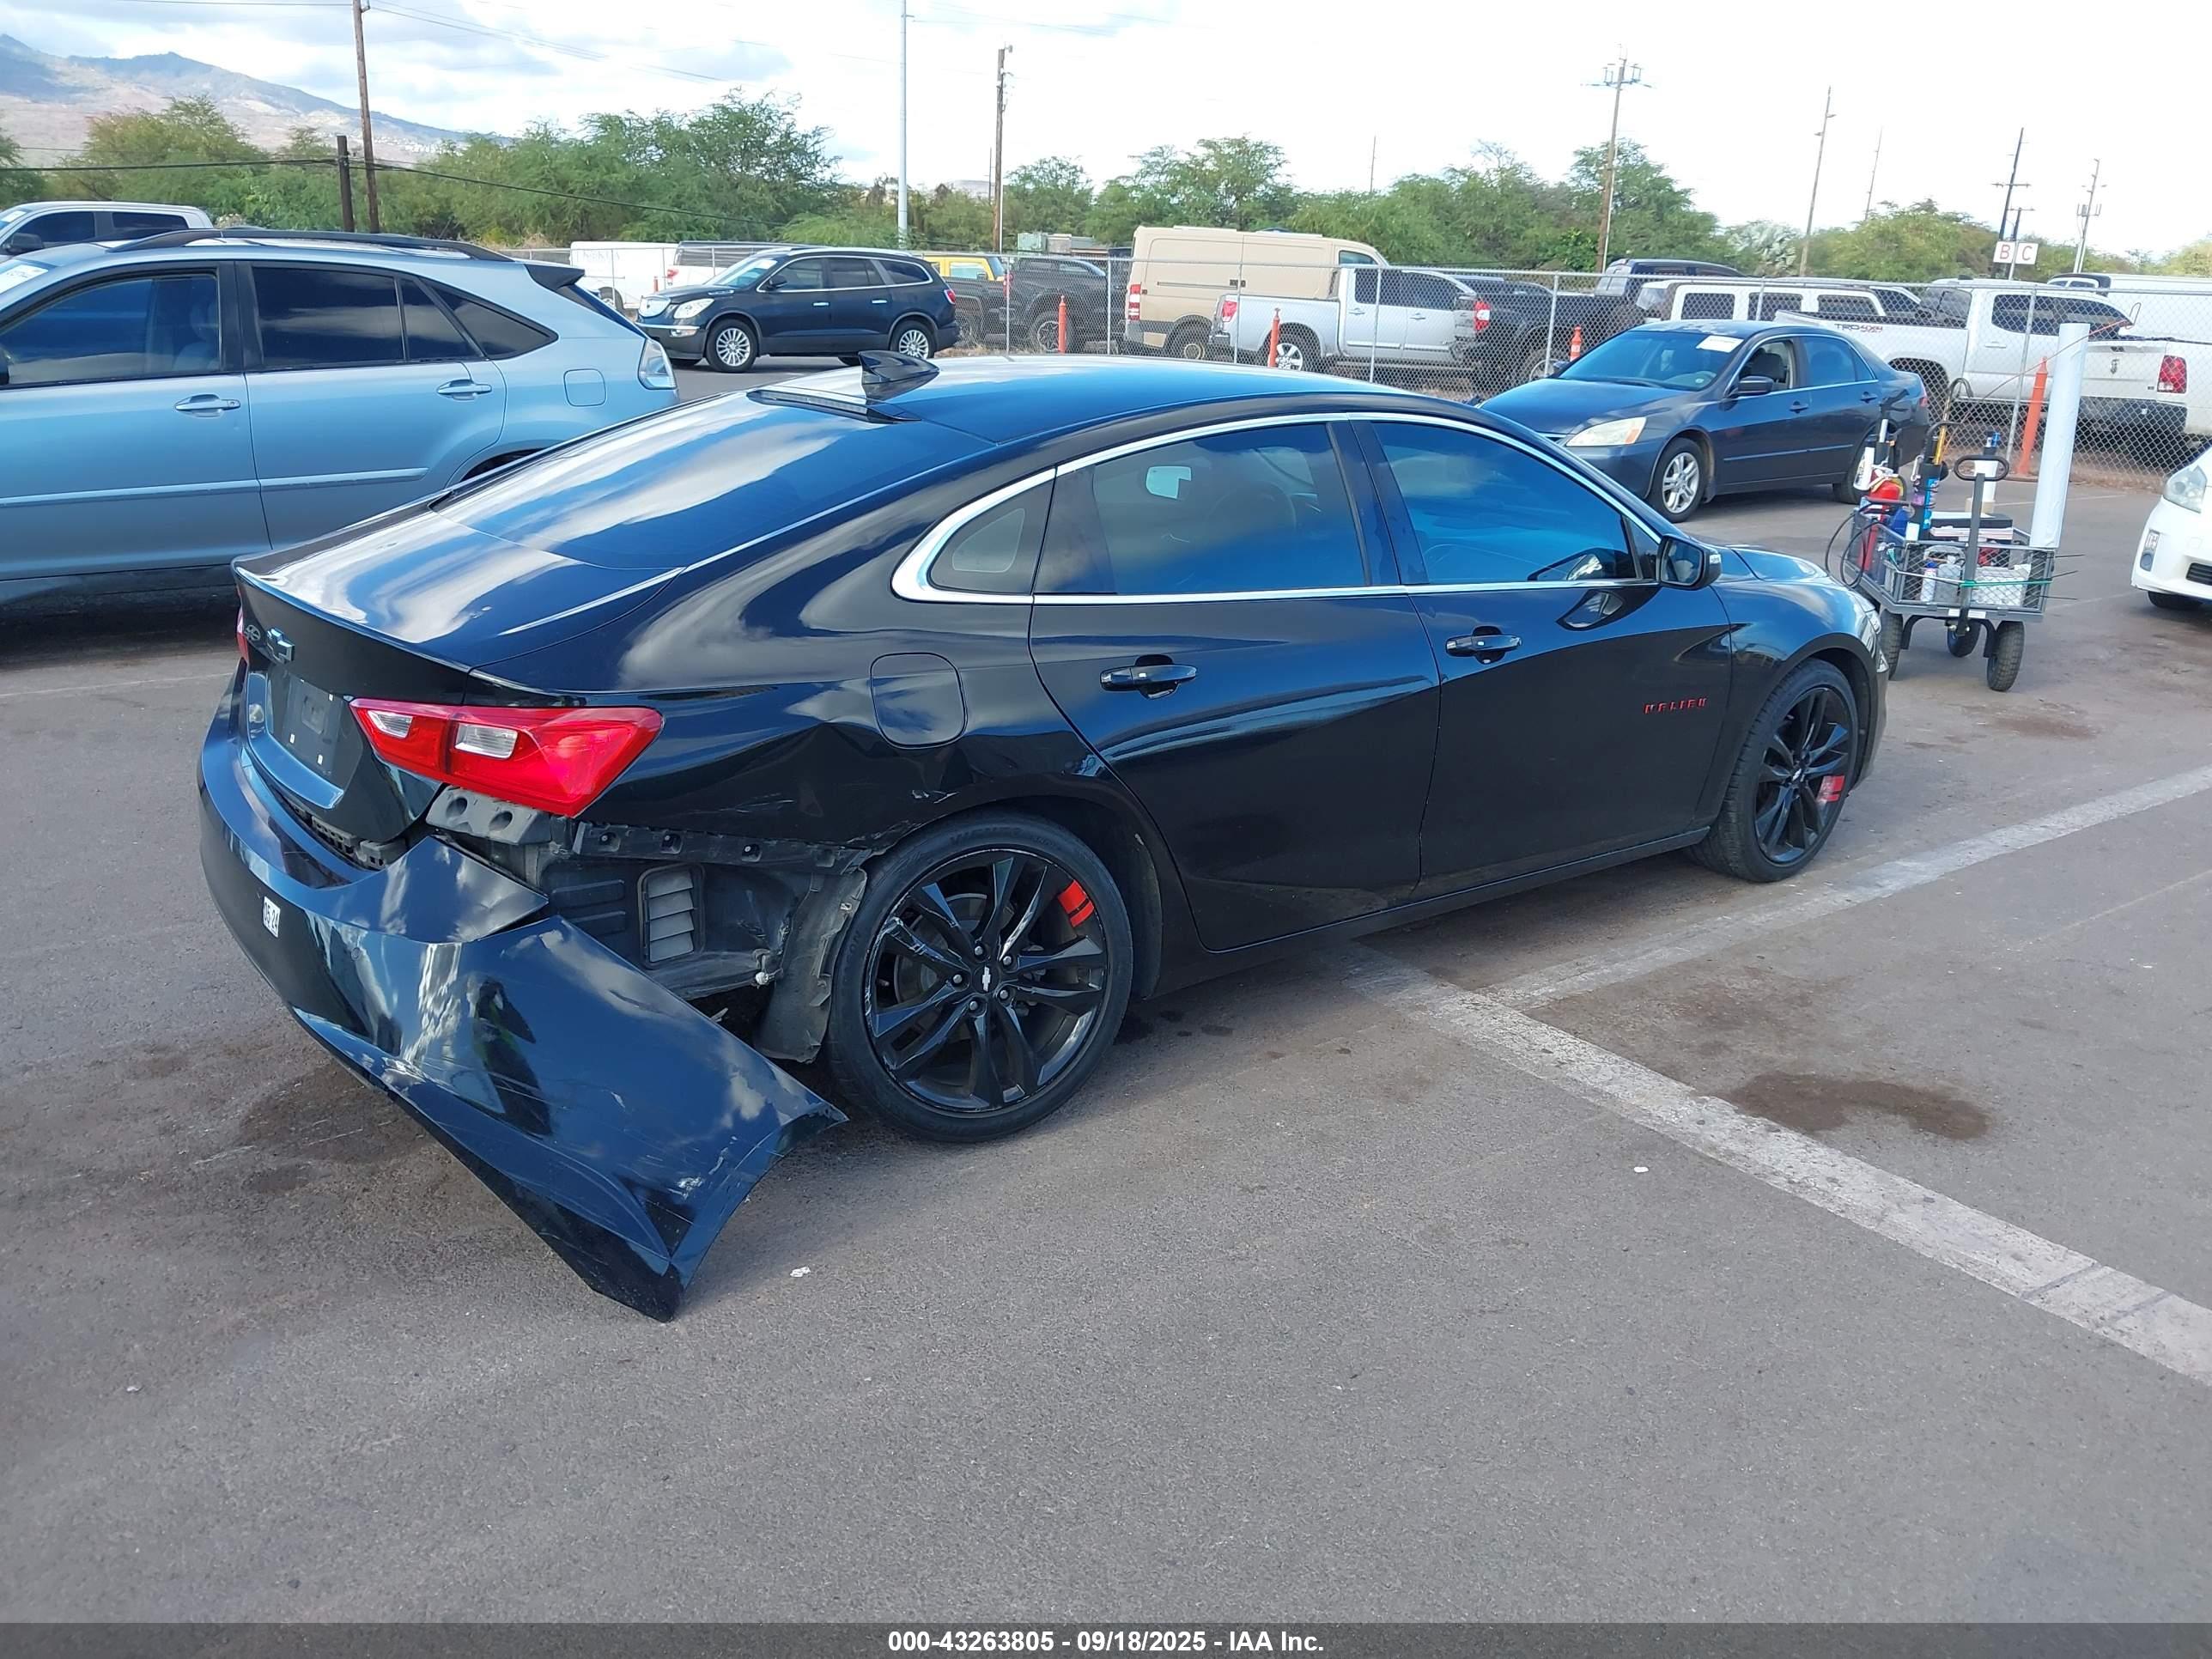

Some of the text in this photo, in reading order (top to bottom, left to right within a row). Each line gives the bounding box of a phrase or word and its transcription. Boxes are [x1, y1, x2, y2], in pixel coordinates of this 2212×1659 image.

[2000, 244, 2011, 259] B
[2022, 246, 2033, 261] C
[1834, 323, 1859, 331] TRD
